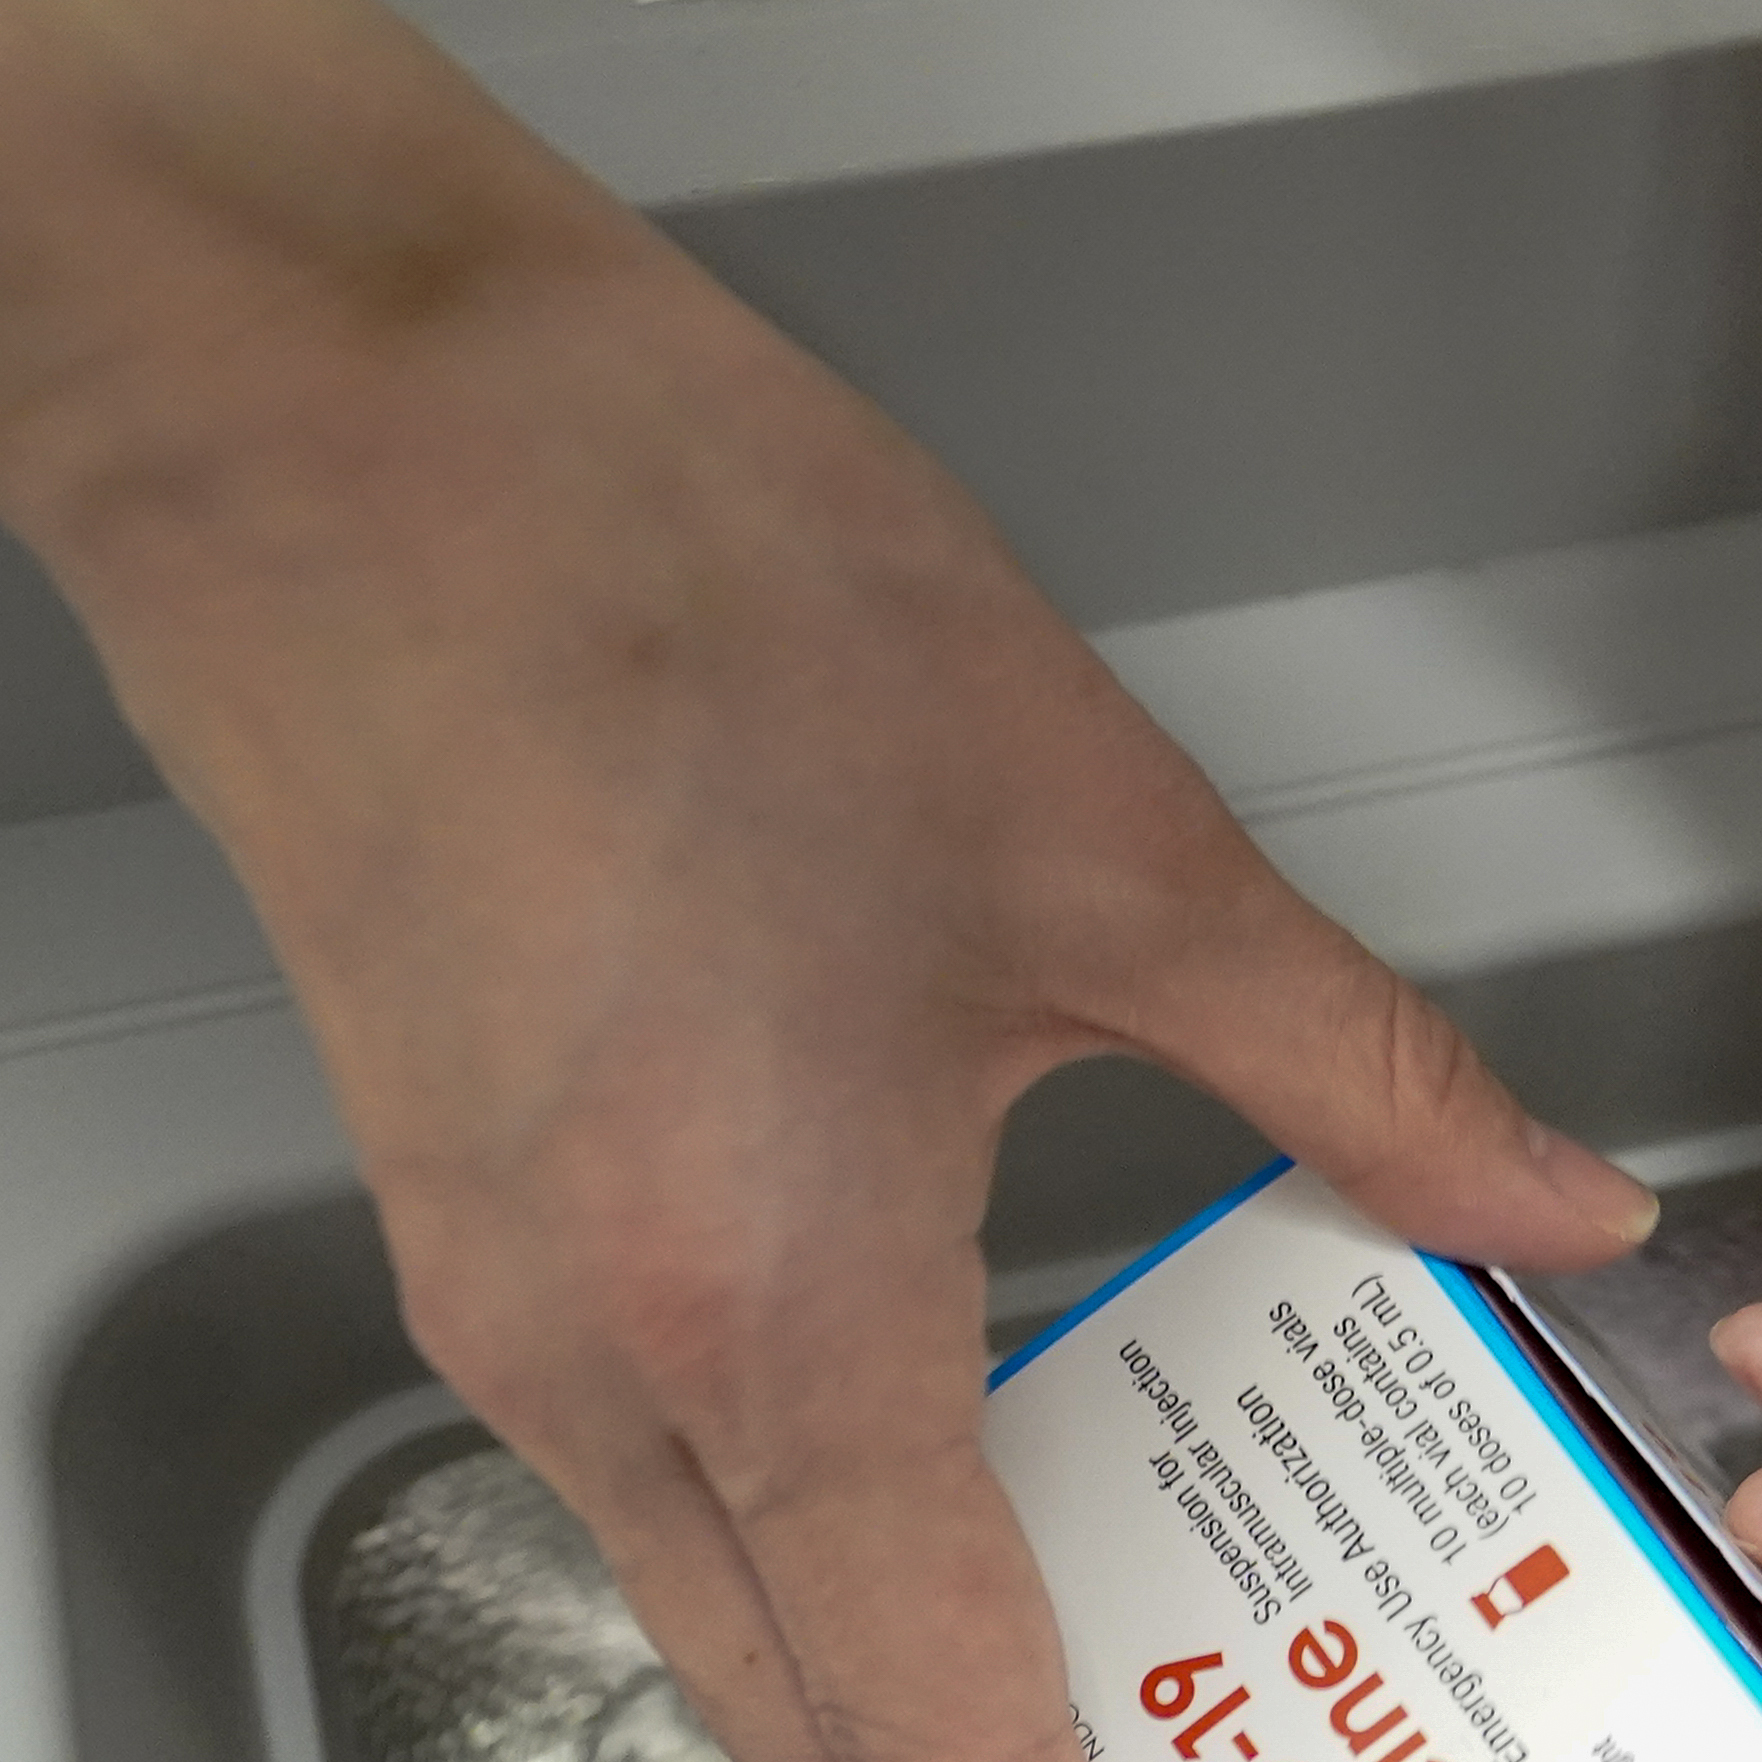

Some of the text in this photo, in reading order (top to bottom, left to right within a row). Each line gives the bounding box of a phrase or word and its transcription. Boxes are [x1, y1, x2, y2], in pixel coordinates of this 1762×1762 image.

[1118, 1338, 1313, 1602] Intramuscular Injection
[1236, 1383, 1375, 1562] Authorization
[1268, 1301, 1467, 1565] 10 multiple-dose vials
[1333, 1316, 1509, 1538] (each vial contains
[1351, 1274, 1537, 1515] 10 doses of 0.5 mL)
[1148, 1450, 1282, 1625] Suspension for
[1363, 1559, 1413, 1622] Use
